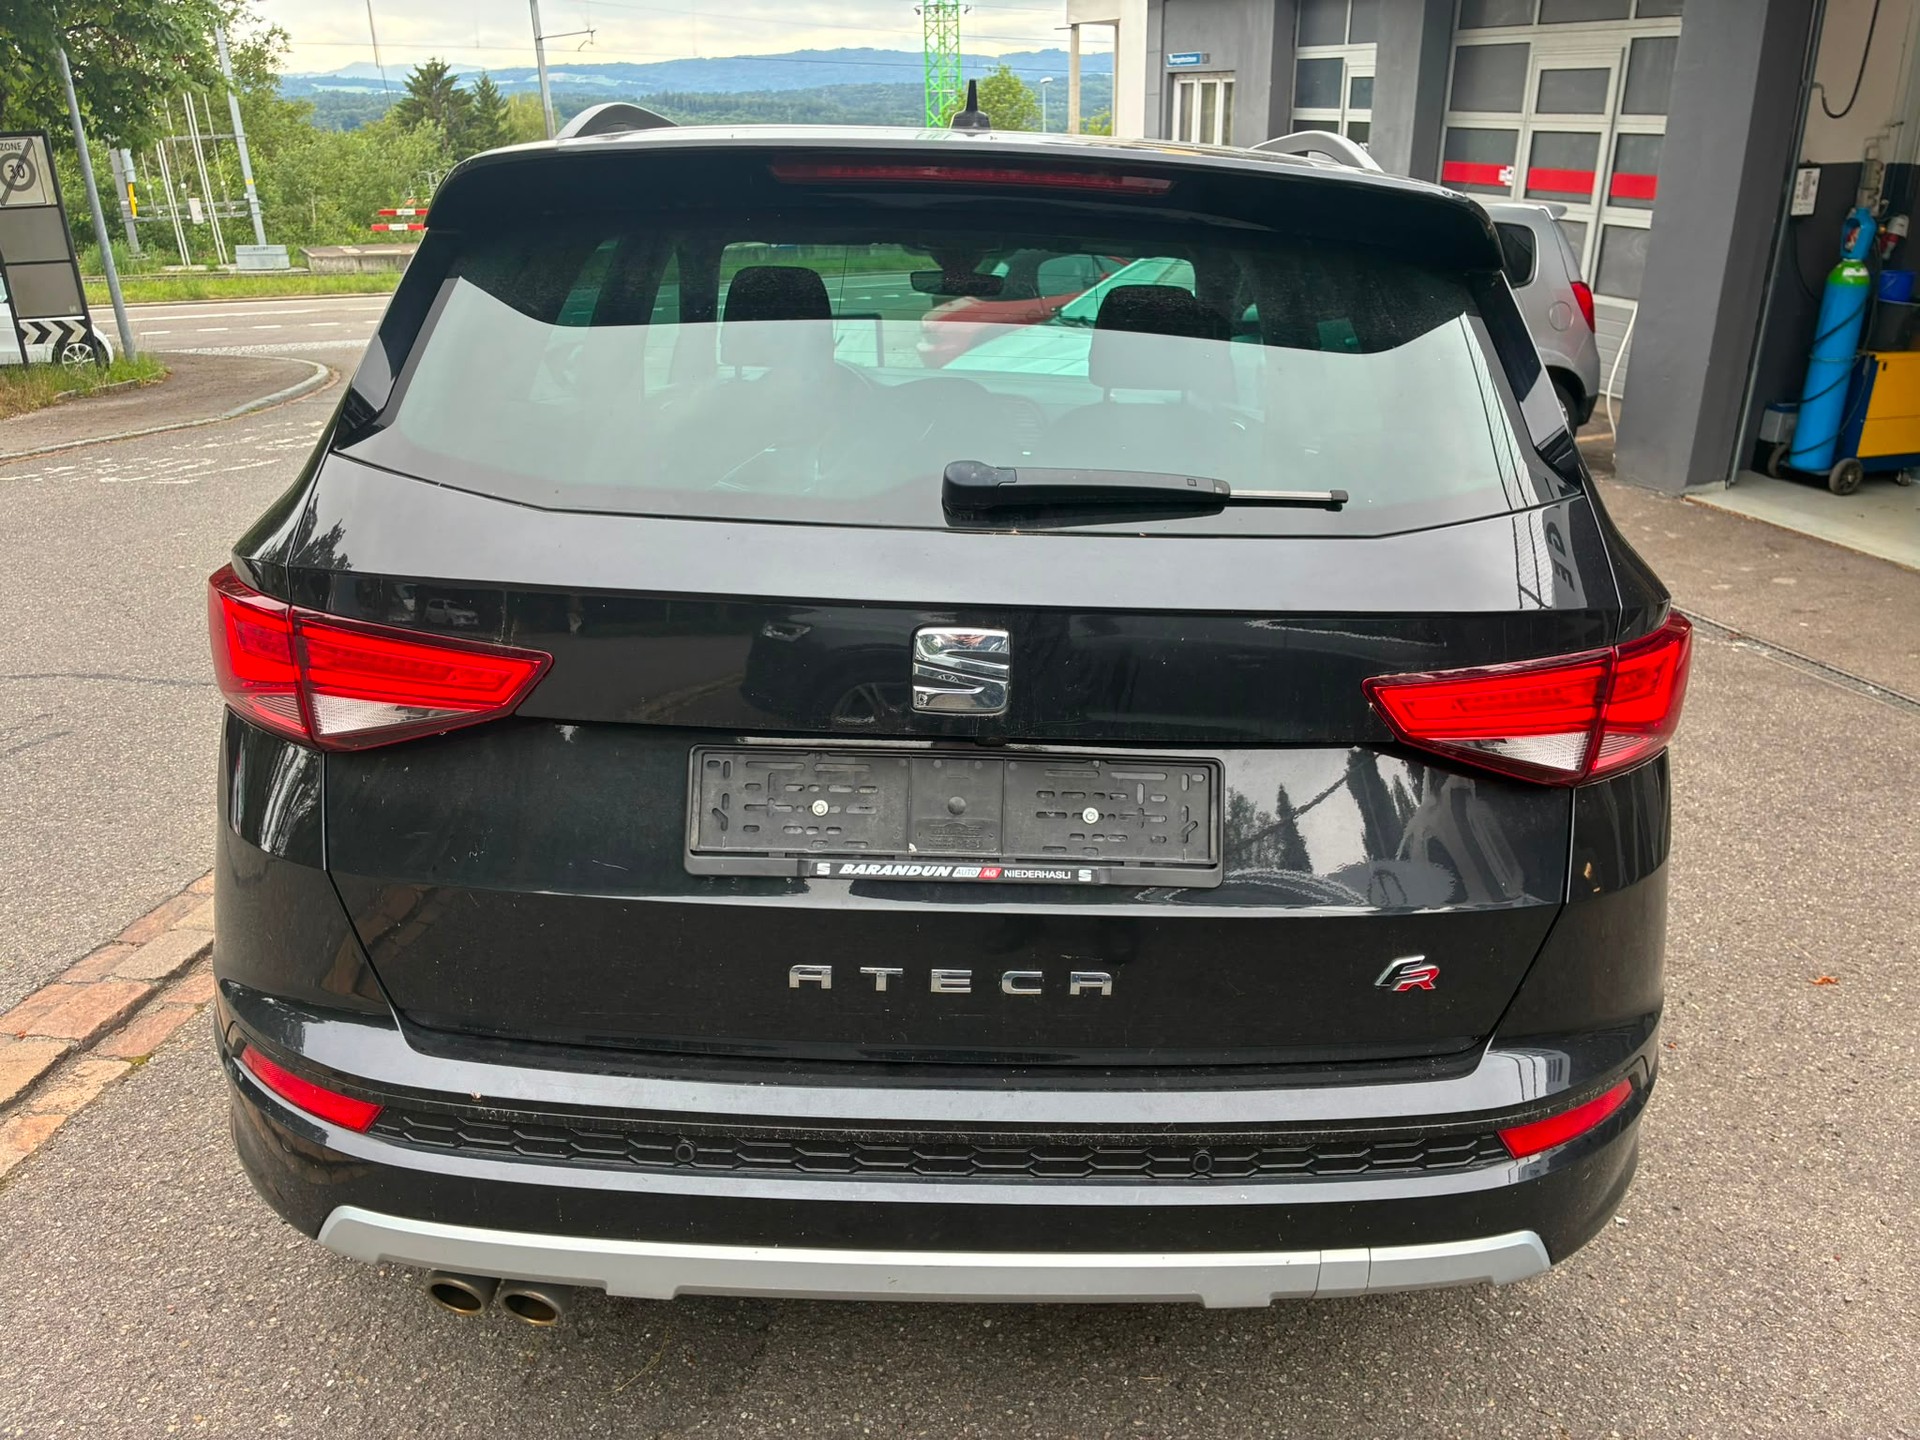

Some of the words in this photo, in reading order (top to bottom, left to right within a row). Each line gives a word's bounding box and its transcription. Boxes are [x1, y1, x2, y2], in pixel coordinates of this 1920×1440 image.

[0, 142, 22, 151] ZONE
[839, 863, 953, 877] BARANDUN
[955, 867, 978, 876] AUTO
[1004, 869, 1071, 879] NIEDERHASLI
[789, 965, 1113, 995] ATECA
[1374, 955, 1439, 991] FR
